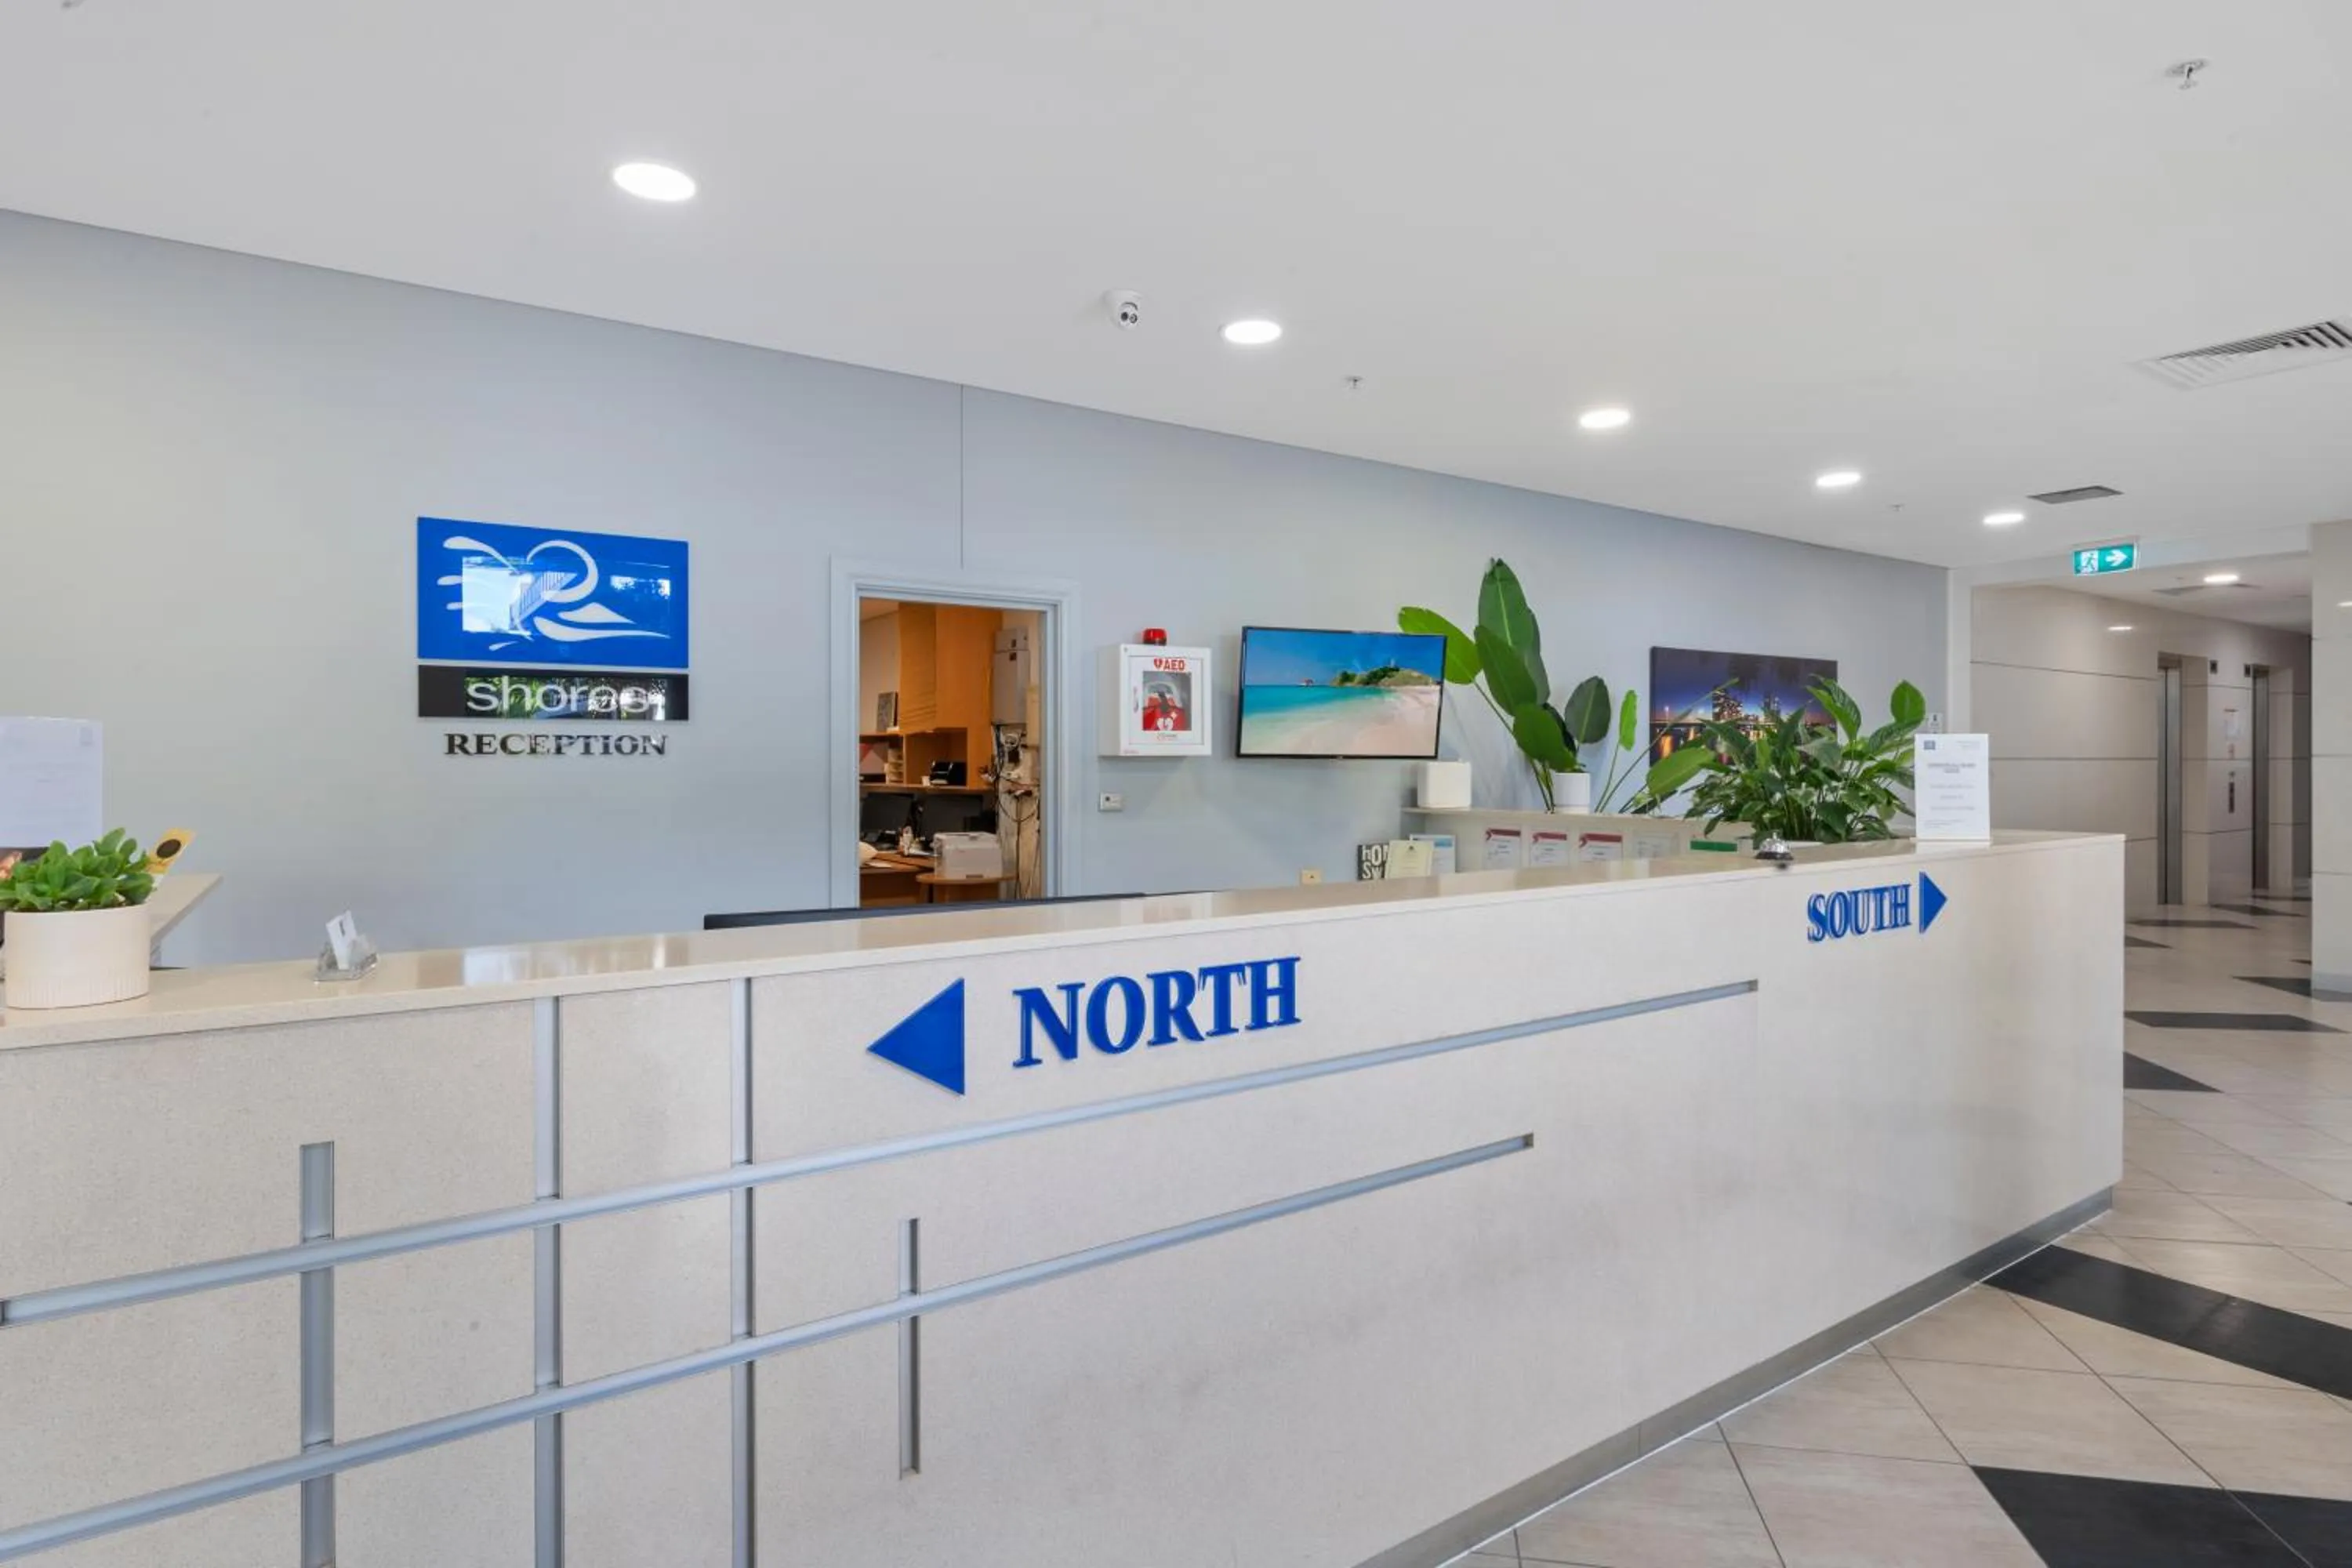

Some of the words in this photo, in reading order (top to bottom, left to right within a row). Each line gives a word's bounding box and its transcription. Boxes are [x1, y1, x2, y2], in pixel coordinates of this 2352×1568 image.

[1163, 659, 1185, 670] AED
[445, 733, 669, 755] RECEPTION
[1807, 884, 1912, 942] SOUTH
[1012, 956, 1302, 1068] NORTH
